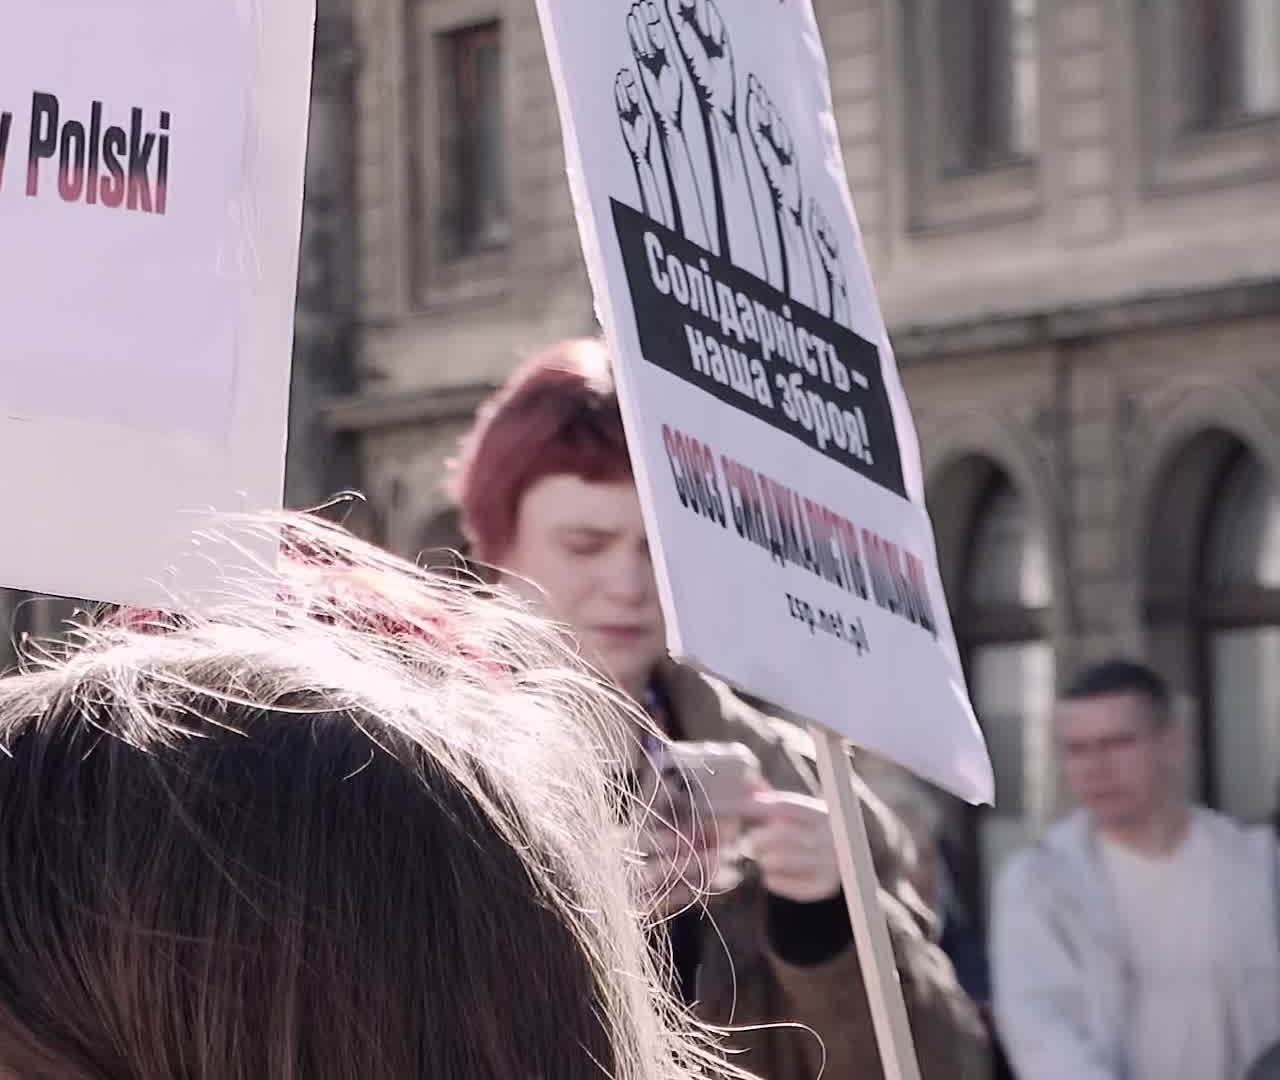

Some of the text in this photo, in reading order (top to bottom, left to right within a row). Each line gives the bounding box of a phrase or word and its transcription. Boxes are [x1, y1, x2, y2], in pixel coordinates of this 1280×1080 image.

[24, 90, 172, 216] Polski
[683, 323, 875, 466] наша зброя!
